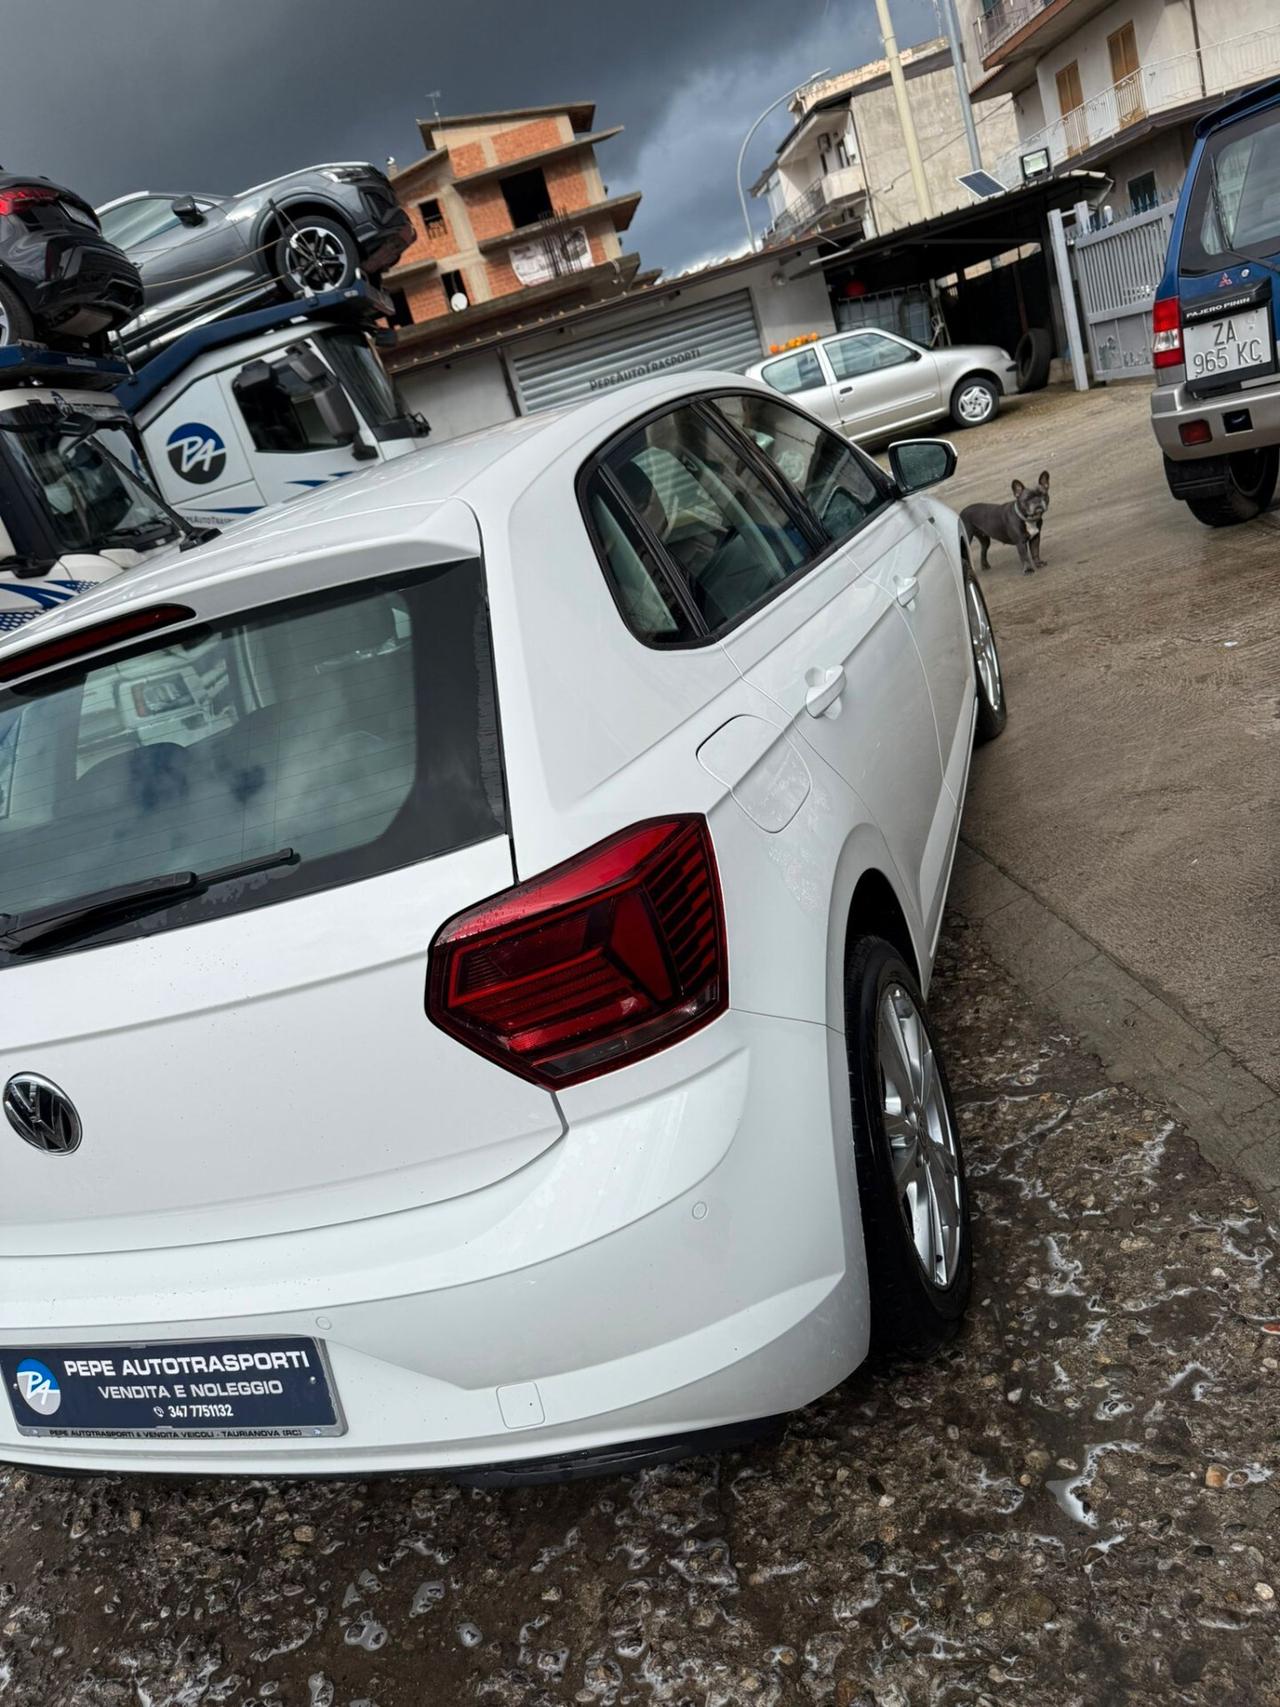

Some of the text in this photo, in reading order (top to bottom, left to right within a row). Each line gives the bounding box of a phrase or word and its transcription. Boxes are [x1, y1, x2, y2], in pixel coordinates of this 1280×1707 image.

[1186, 297, 1251, 318] PAJERO PININ
[1213, 319, 1238, 346] ZA
[1193, 338, 1263, 376] 965 KC
[63, 1350, 311, 1377] PEPE AUTOTRASPORTI
[98, 1379, 284, 1400] VENDITA E NOLEGGIO
[167, 1403, 234, 1418] 347 7751132
[49, 1429, 69, 1437] PEPE
[71, 1430, 134, 1438] AUTOTRASPORTI
[144, 1431, 179, 1439] VENDITA
[180, 1431, 215, 1439] VEICOLI
[221, 1430, 281, 1438] TAURIANOVA
[283, 1429, 303, 1437] (RC)
